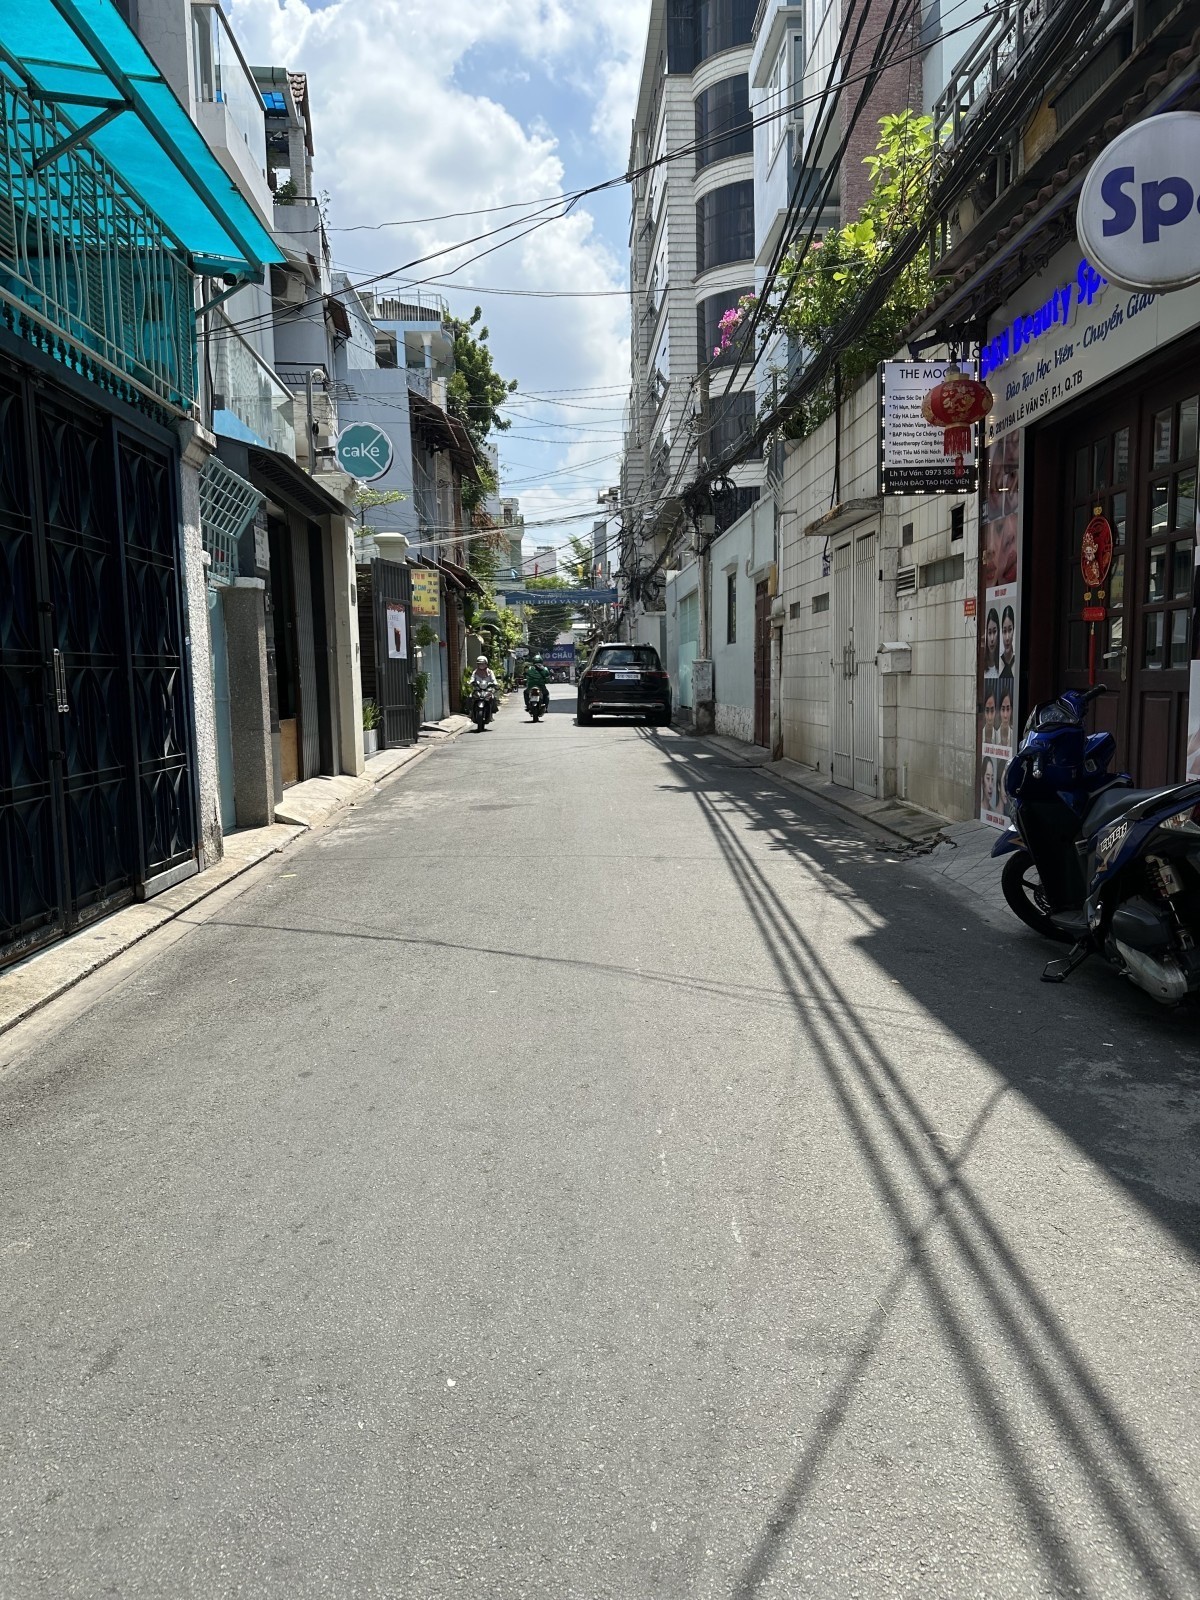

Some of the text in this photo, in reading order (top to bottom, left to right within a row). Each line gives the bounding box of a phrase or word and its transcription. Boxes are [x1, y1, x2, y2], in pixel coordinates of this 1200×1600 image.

[1101, 166, 1200, 244] Sp
[1013, 283, 1072, 355] Beauty
[1077, 257, 1108, 306] Sp
[1021, 371, 1035, 392] Tạo
[1035, 357, 1052, 383] Học
[1054, 342, 1075, 369] Viên
[1083, 303, 1124, 350] Chuyển
[900, 369, 920, 379] THE
[1017, 404, 1025, 421] LÊ
[1026, 396, 1039, 417] VĂN
[1064, 369, 1083, 391] Q.TB
[889, 479, 909, 488] NHẬN
[926, 478, 939, 487] TẠO
[940, 477, 955, 487] HỌC
[955, 476, 970, 485] VIÊN
[943, 468, 955, 476] 583
[551, 650, 573, 659] CHÂU
